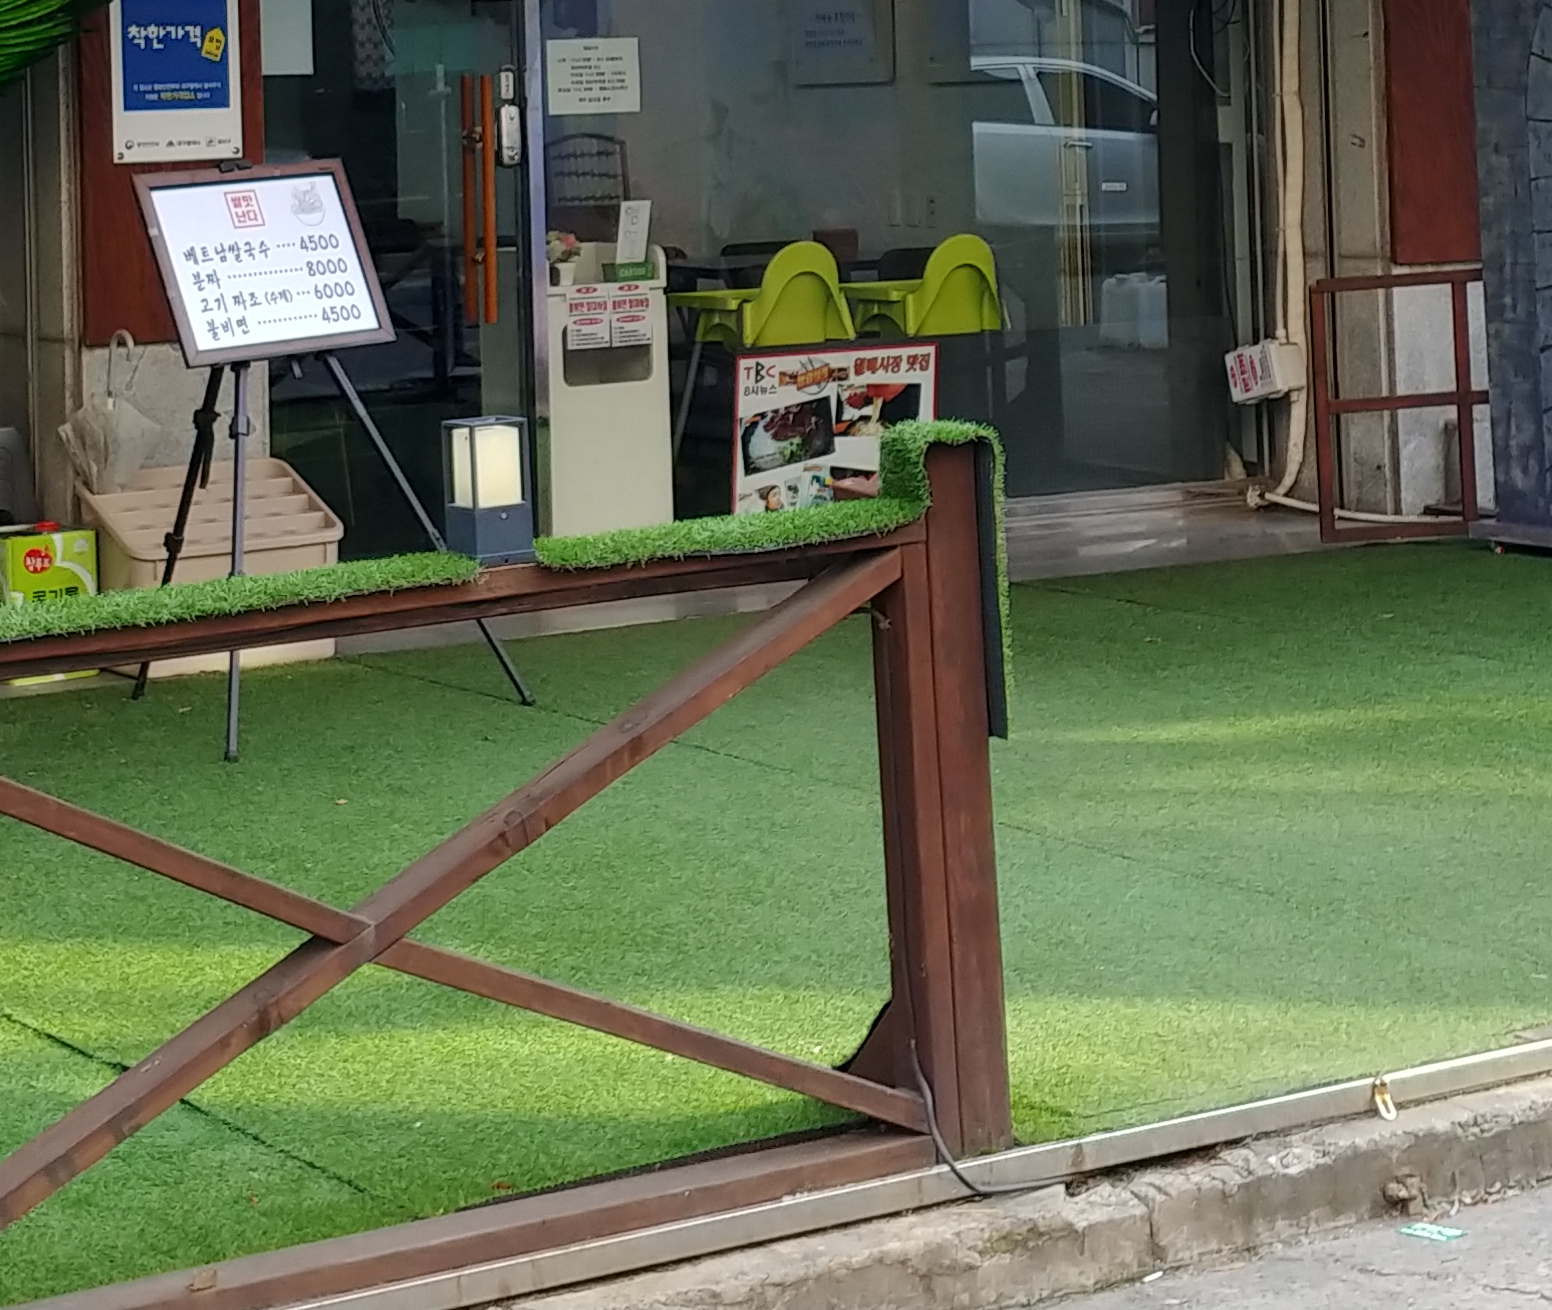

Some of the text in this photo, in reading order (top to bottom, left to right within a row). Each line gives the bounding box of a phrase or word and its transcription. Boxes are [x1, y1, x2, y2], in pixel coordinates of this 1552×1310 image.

[127, 23, 202, 50] 착한가격
[182, 233, 340, 266] 베트남쌀국수 4500
[192, 257, 348, 292] 분짜 8000
[200, 293, 228, 314] 고기
[232, 291, 262, 311] 짜조
[314, 281, 356, 300] 6000
[206, 304, 362, 341] 불비면 4500
[744, 361, 776, 383] TBC
